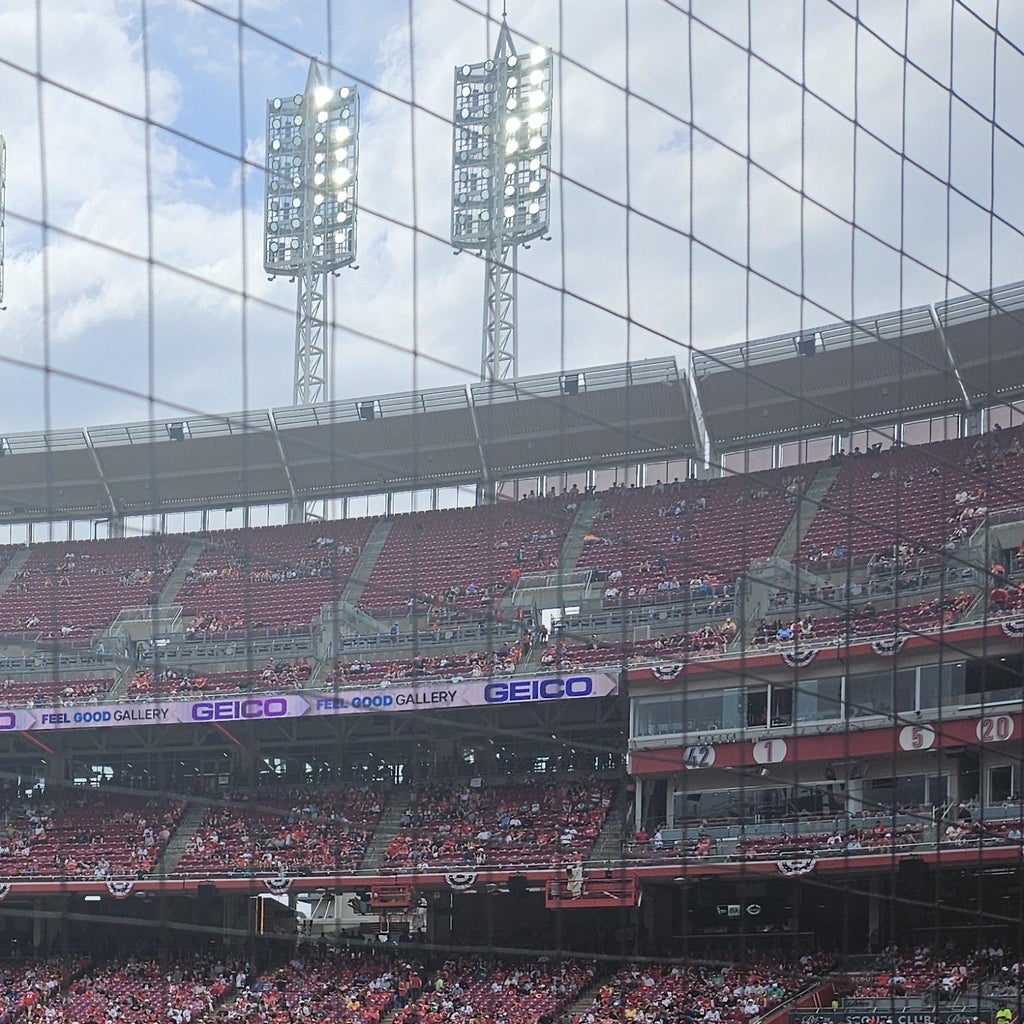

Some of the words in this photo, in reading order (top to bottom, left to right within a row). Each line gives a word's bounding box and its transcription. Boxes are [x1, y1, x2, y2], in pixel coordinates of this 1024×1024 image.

[483, 676, 593, 702] GEICO
[191, 698, 287, 721] GEICO
[316, 698, 348, 710] FEEL
[351, 695, 393, 708] GOOD
[395, 690, 457, 705] GALLERY
[41, 713, 71, 725] FEEL
[73, 711, 111, 723] GOOD
[113, 708, 169, 721] GALLERY
[911, 727, 924, 748] 5
[982, 717, 1009, 740] 20
[687, 747, 710, 767] 42
[764, 741, 773, 762] 1
[897, 1015, 932, 1024] CLUB
